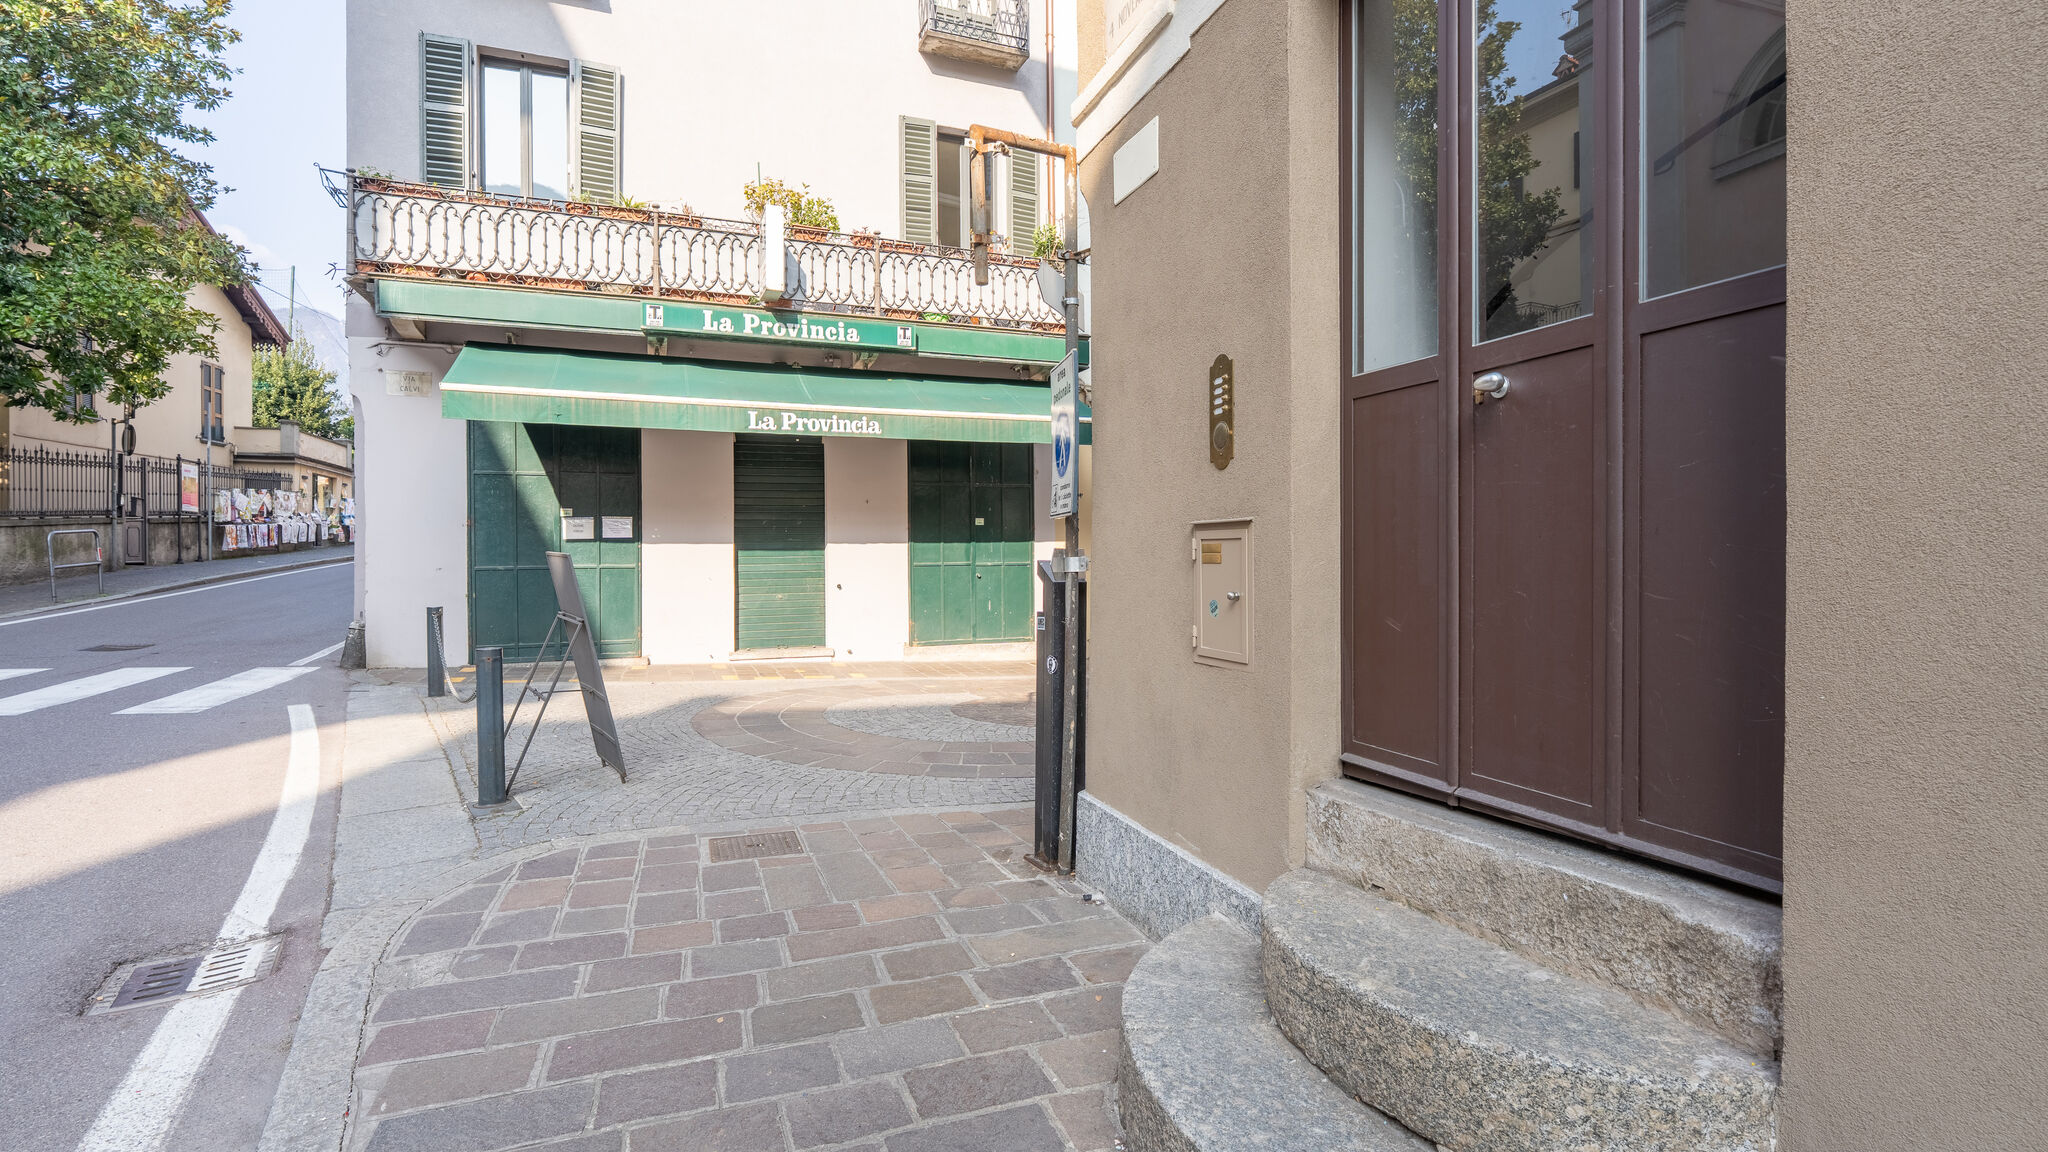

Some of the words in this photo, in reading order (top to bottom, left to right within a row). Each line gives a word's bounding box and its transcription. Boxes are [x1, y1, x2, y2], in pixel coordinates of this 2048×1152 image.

[702, 309, 735, 333] La
[742, 313, 860, 342] Provincia
[1057, 367, 1067, 383] area
[1053, 381, 1071, 406] pedonale
[748, 410, 778, 430] La
[780, 412, 882, 434] Provincia
